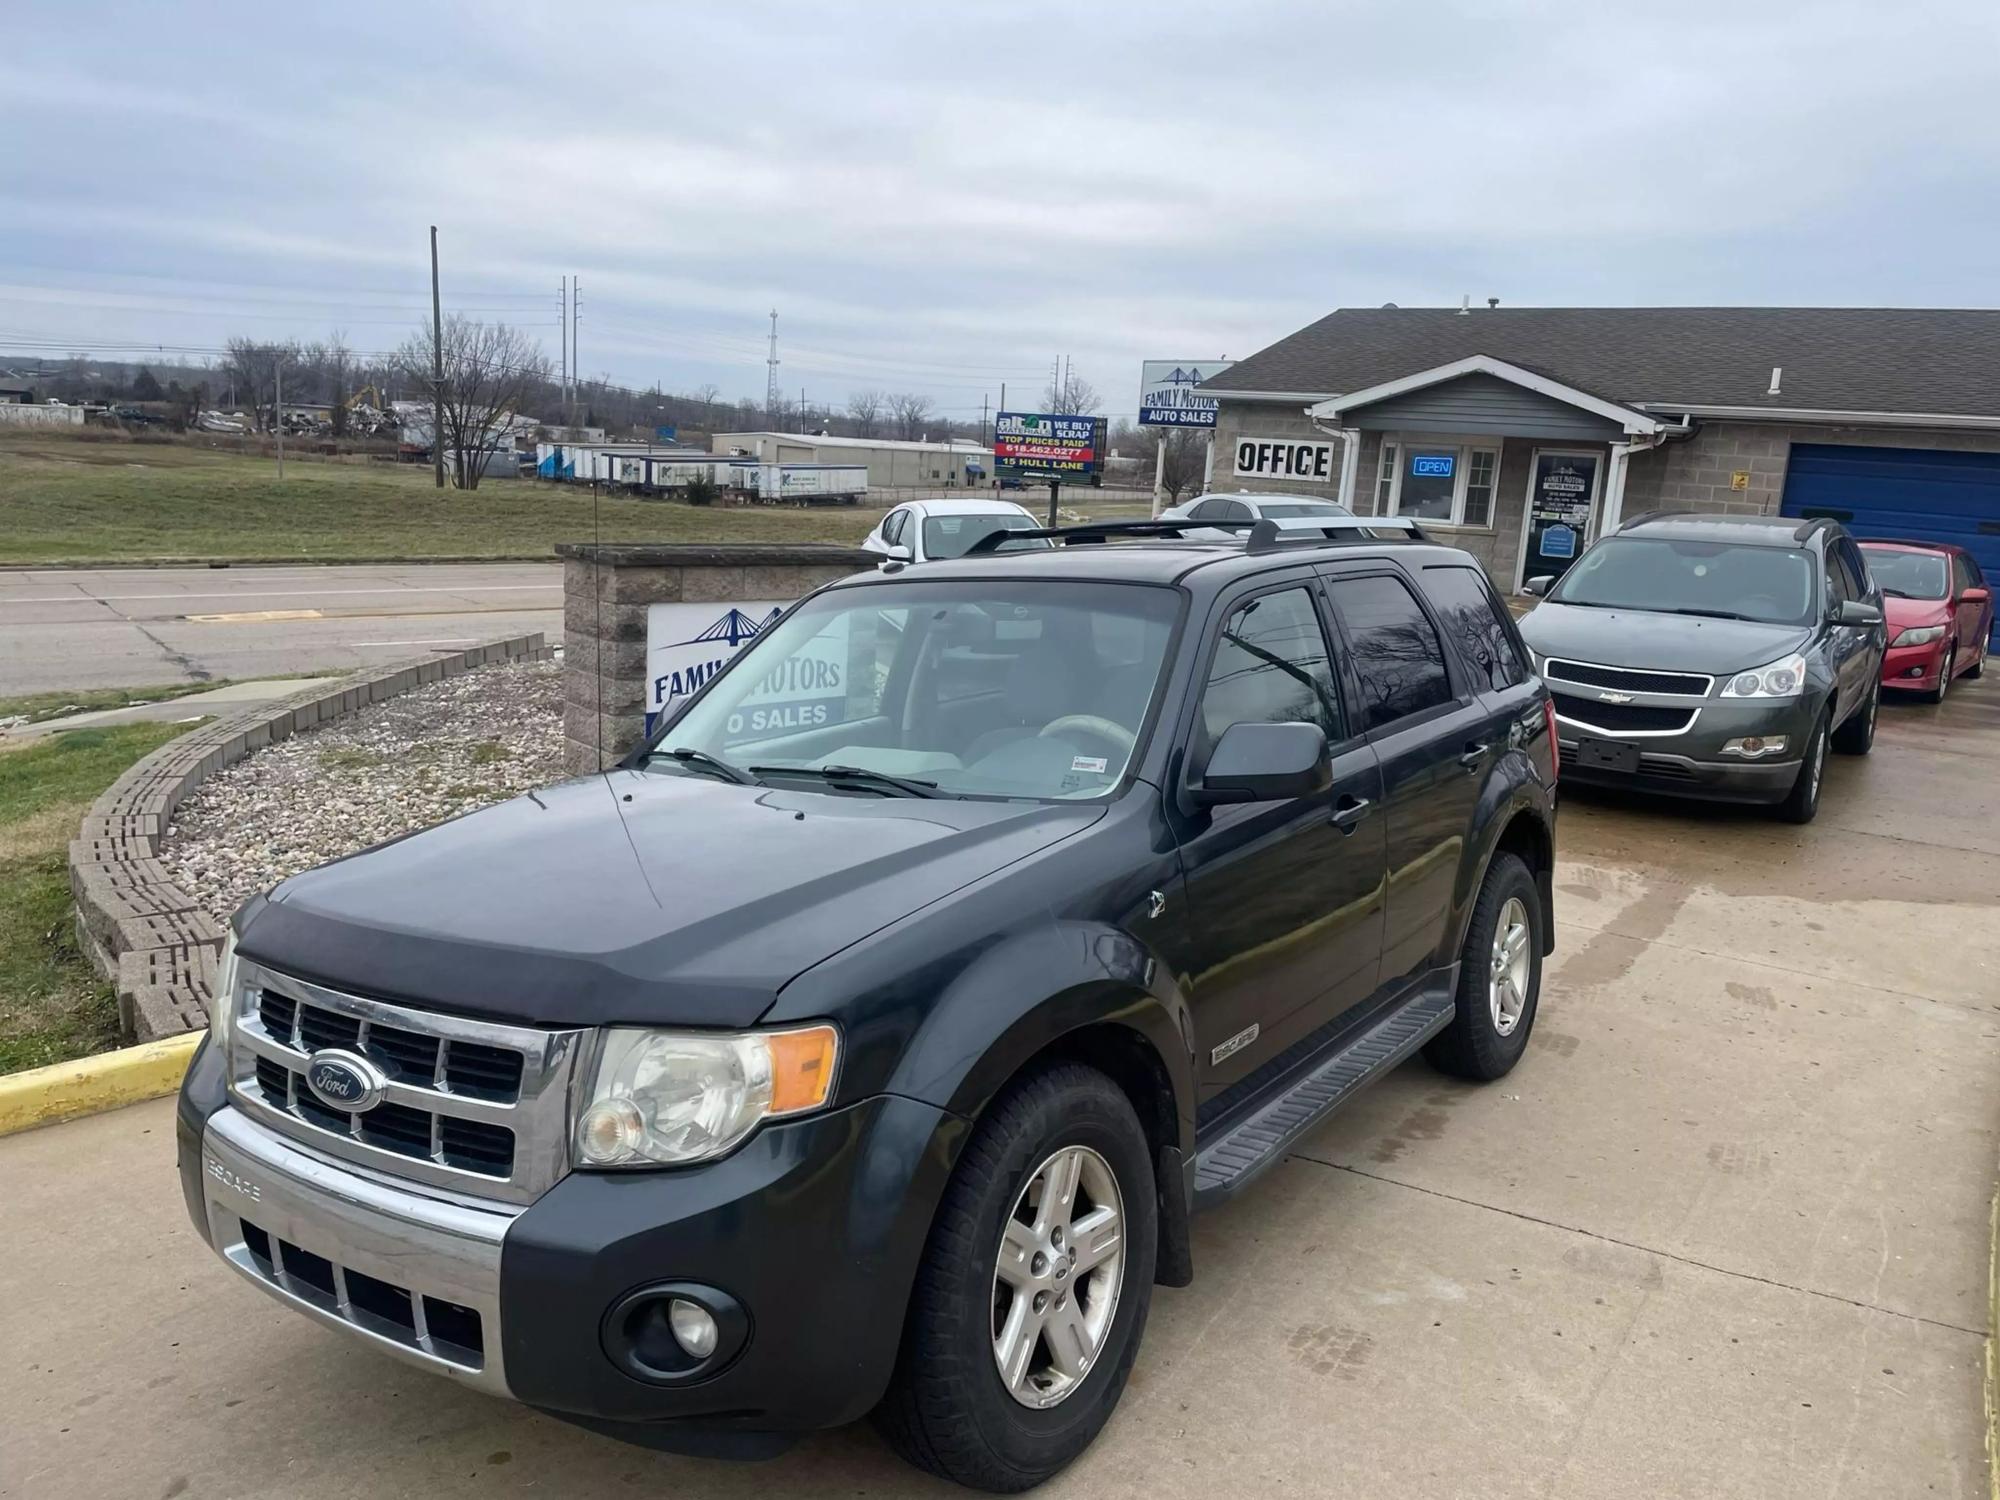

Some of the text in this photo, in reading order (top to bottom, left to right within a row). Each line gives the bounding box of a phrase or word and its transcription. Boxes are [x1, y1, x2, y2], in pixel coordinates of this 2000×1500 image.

[1145, 388, 1180, 407] FAMILY
[1149, 410, 1214, 423] AUTO SALES
[1054, 421, 1093, 431] WE BUY
[1056, 430, 1089, 439] SCRAP
[1026, 437, 1060, 446] PRICES
[1006, 444, 1082, 456] 618.462.0277
[1020, 458, 1049, 468] HULL
[1052, 461, 1084, 470] LANE
[1238, 442, 1330, 477] OFFICE
[1418, 460, 1450, 473] OPEN
[751, 704, 827, 731] SALES
[316, 1065, 351, 1097] Ford
